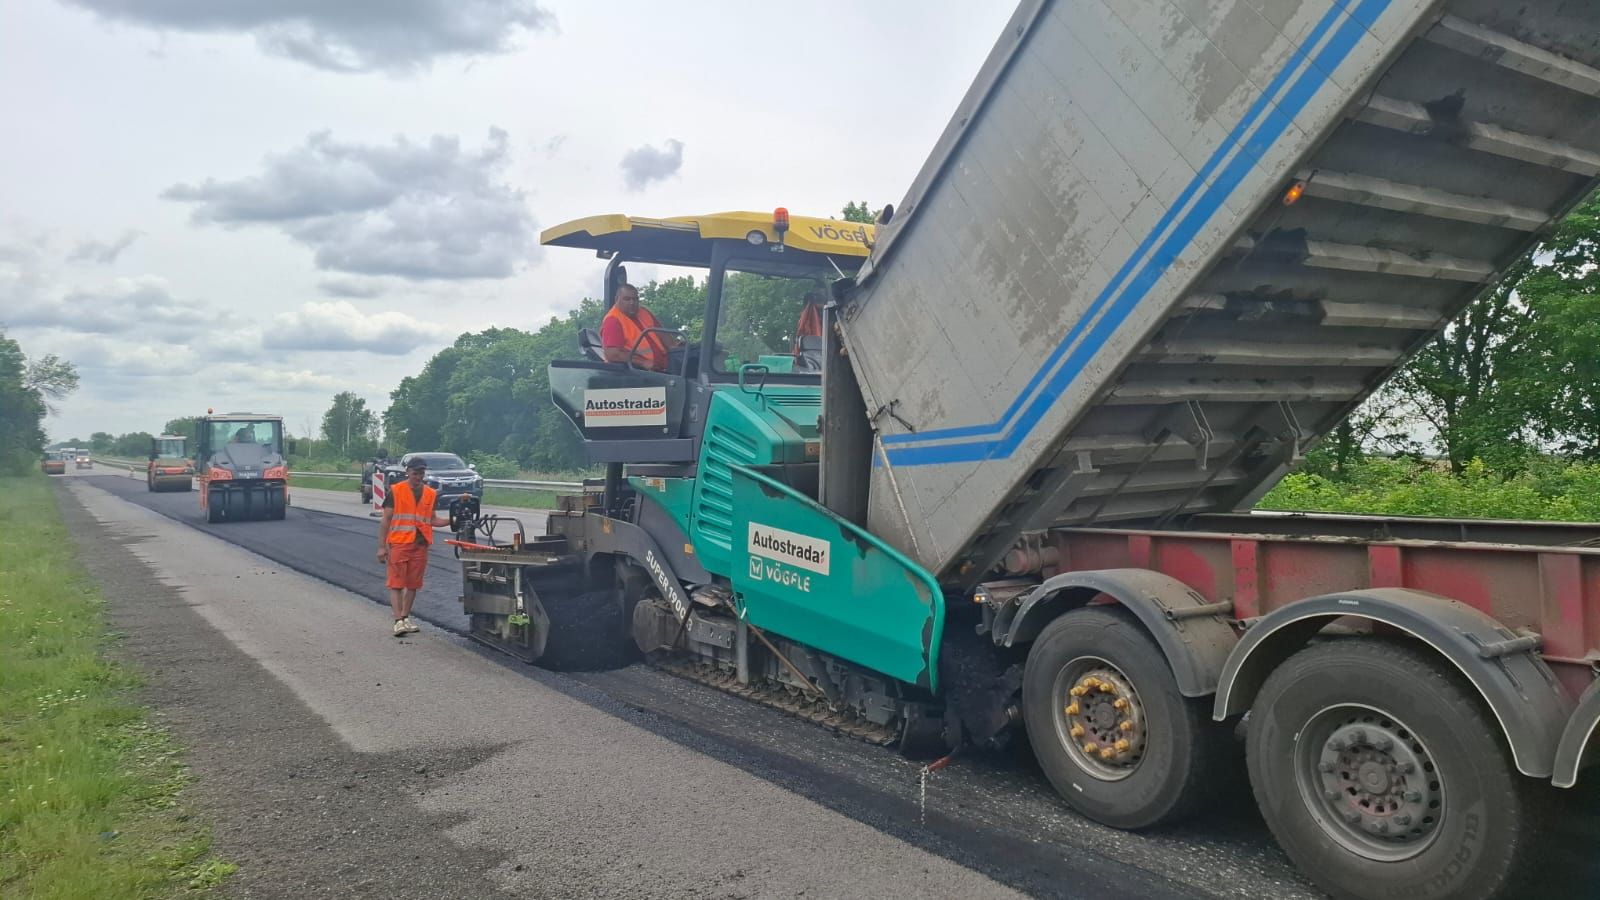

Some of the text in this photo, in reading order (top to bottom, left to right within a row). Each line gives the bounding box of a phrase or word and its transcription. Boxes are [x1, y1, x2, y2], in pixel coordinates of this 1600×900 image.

[586, 398, 659, 410] Autostrada
[753, 530, 820, 564] Autostrada
[646, 549, 669, 592] SUPER
